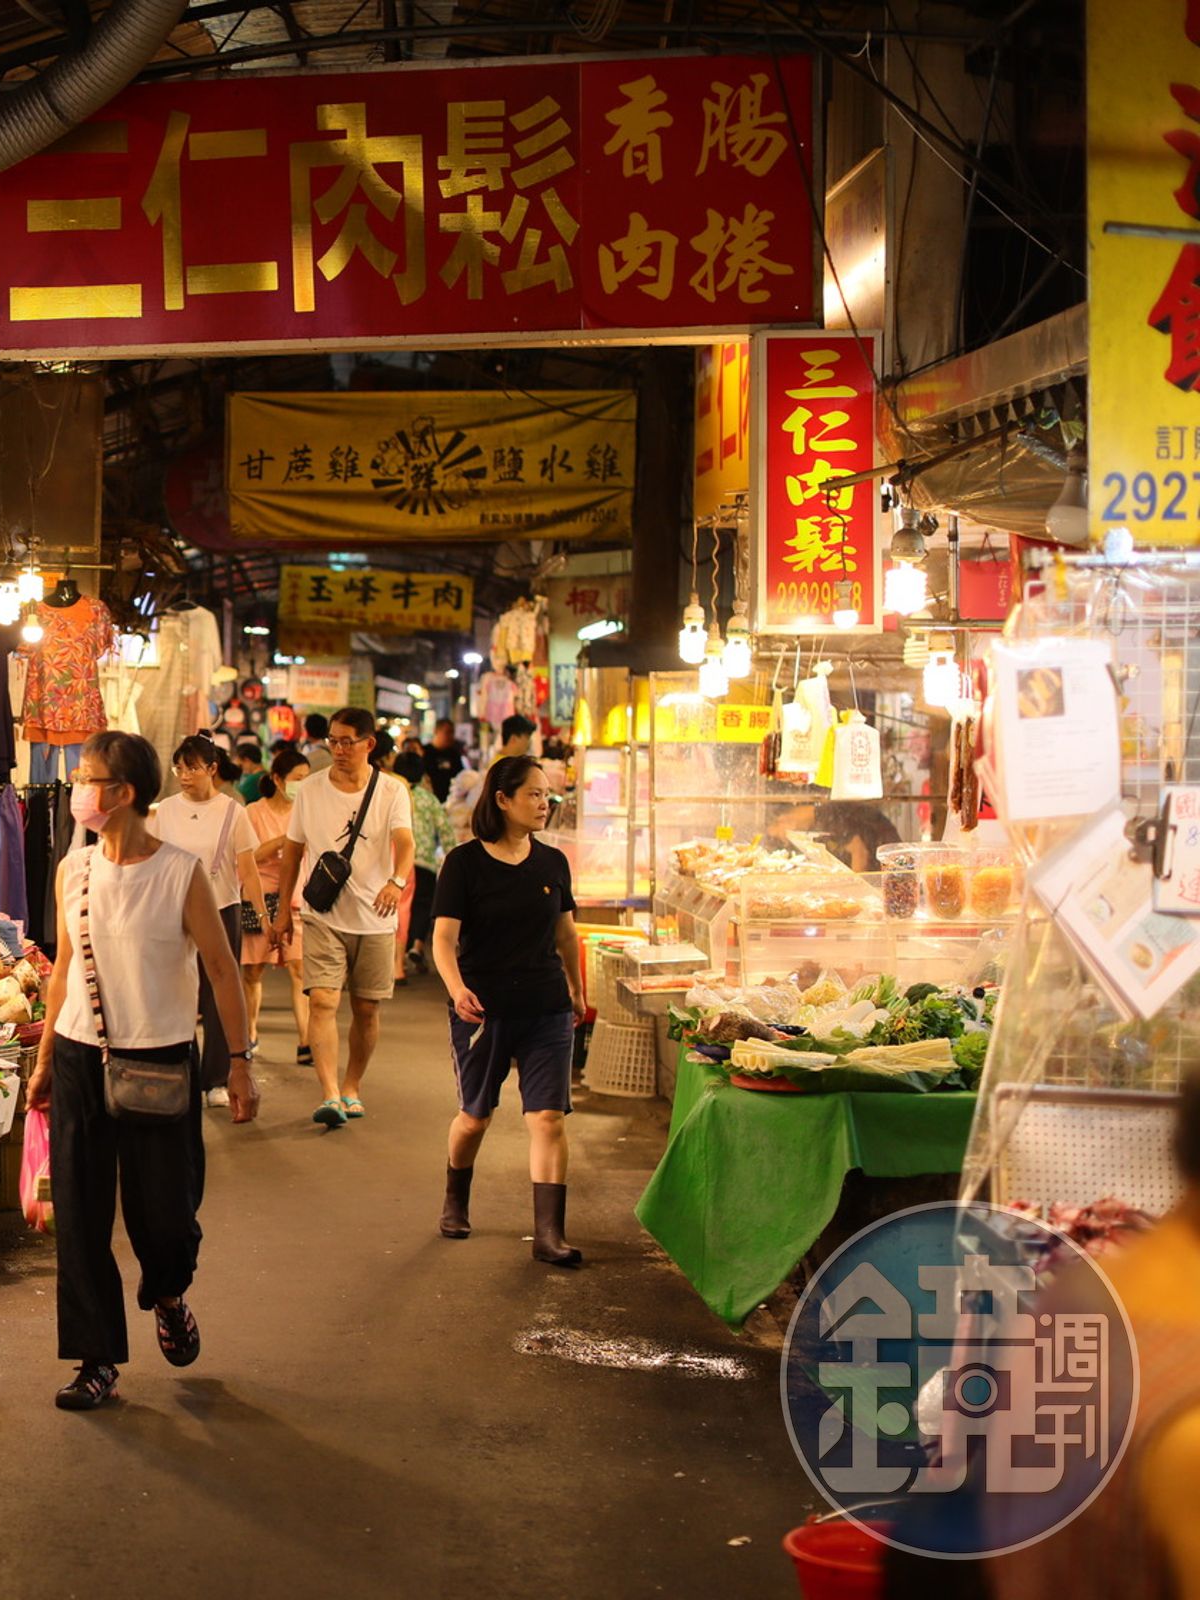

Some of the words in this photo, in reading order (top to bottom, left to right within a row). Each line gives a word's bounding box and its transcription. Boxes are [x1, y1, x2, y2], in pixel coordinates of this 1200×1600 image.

[603, 73, 788, 184] 香腸
[9, 96, 580, 321] 三仁肉鬆
[239, 443, 364, 485] 甘蔗雞
[492, 442, 622, 485] 鹽水雞
[781, 350, 859, 574] 三仁肉鬆
[776, 581, 862, 614] 223298
